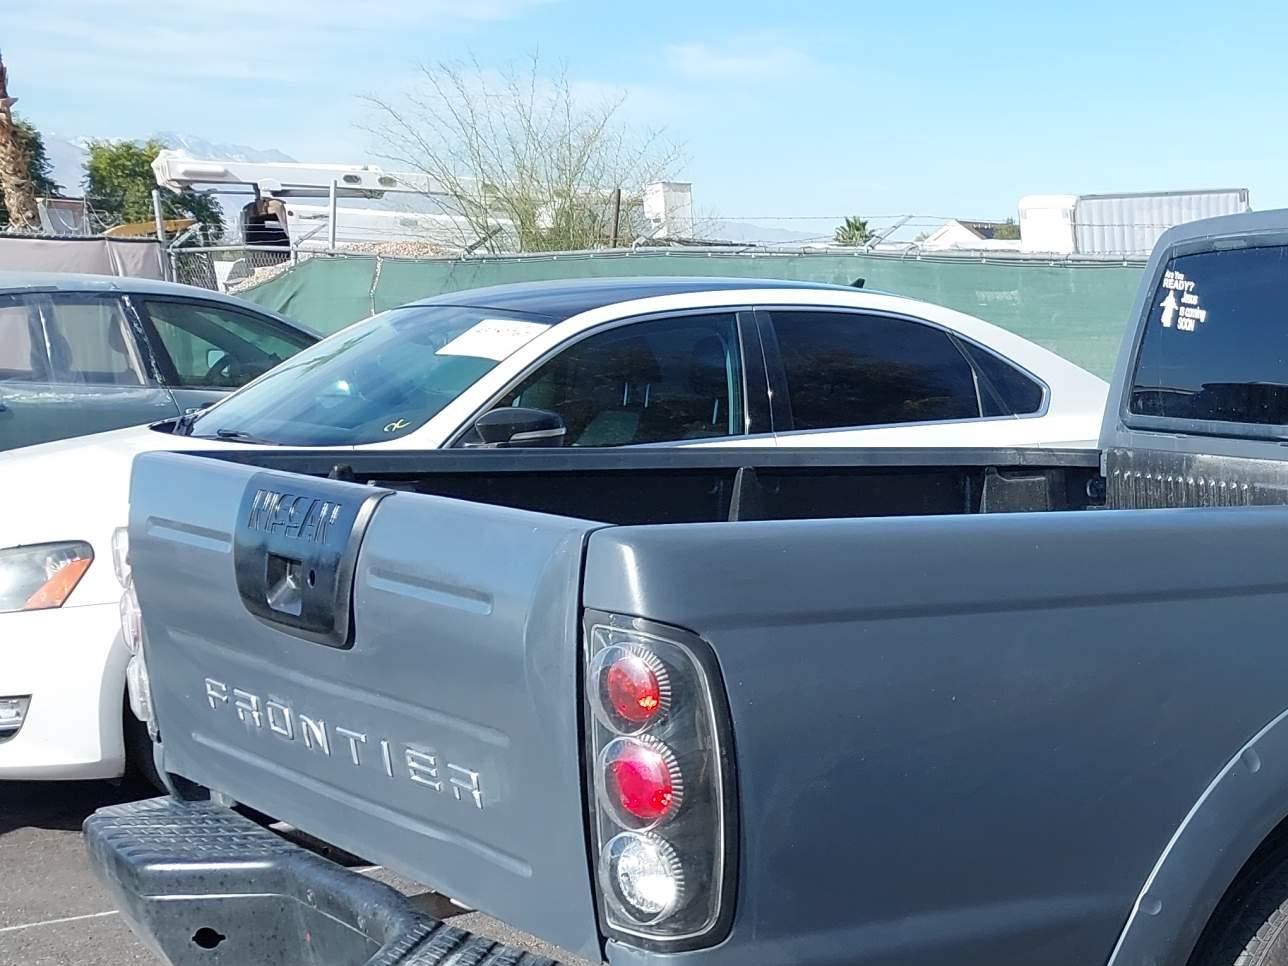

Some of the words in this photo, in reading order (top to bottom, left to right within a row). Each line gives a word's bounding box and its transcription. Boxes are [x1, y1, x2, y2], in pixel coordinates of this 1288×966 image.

[1163, 278, 1196, 291] READY?
[247, 489, 342, 544] NISSAN
[205, 677, 483, 809] FRONTIER
